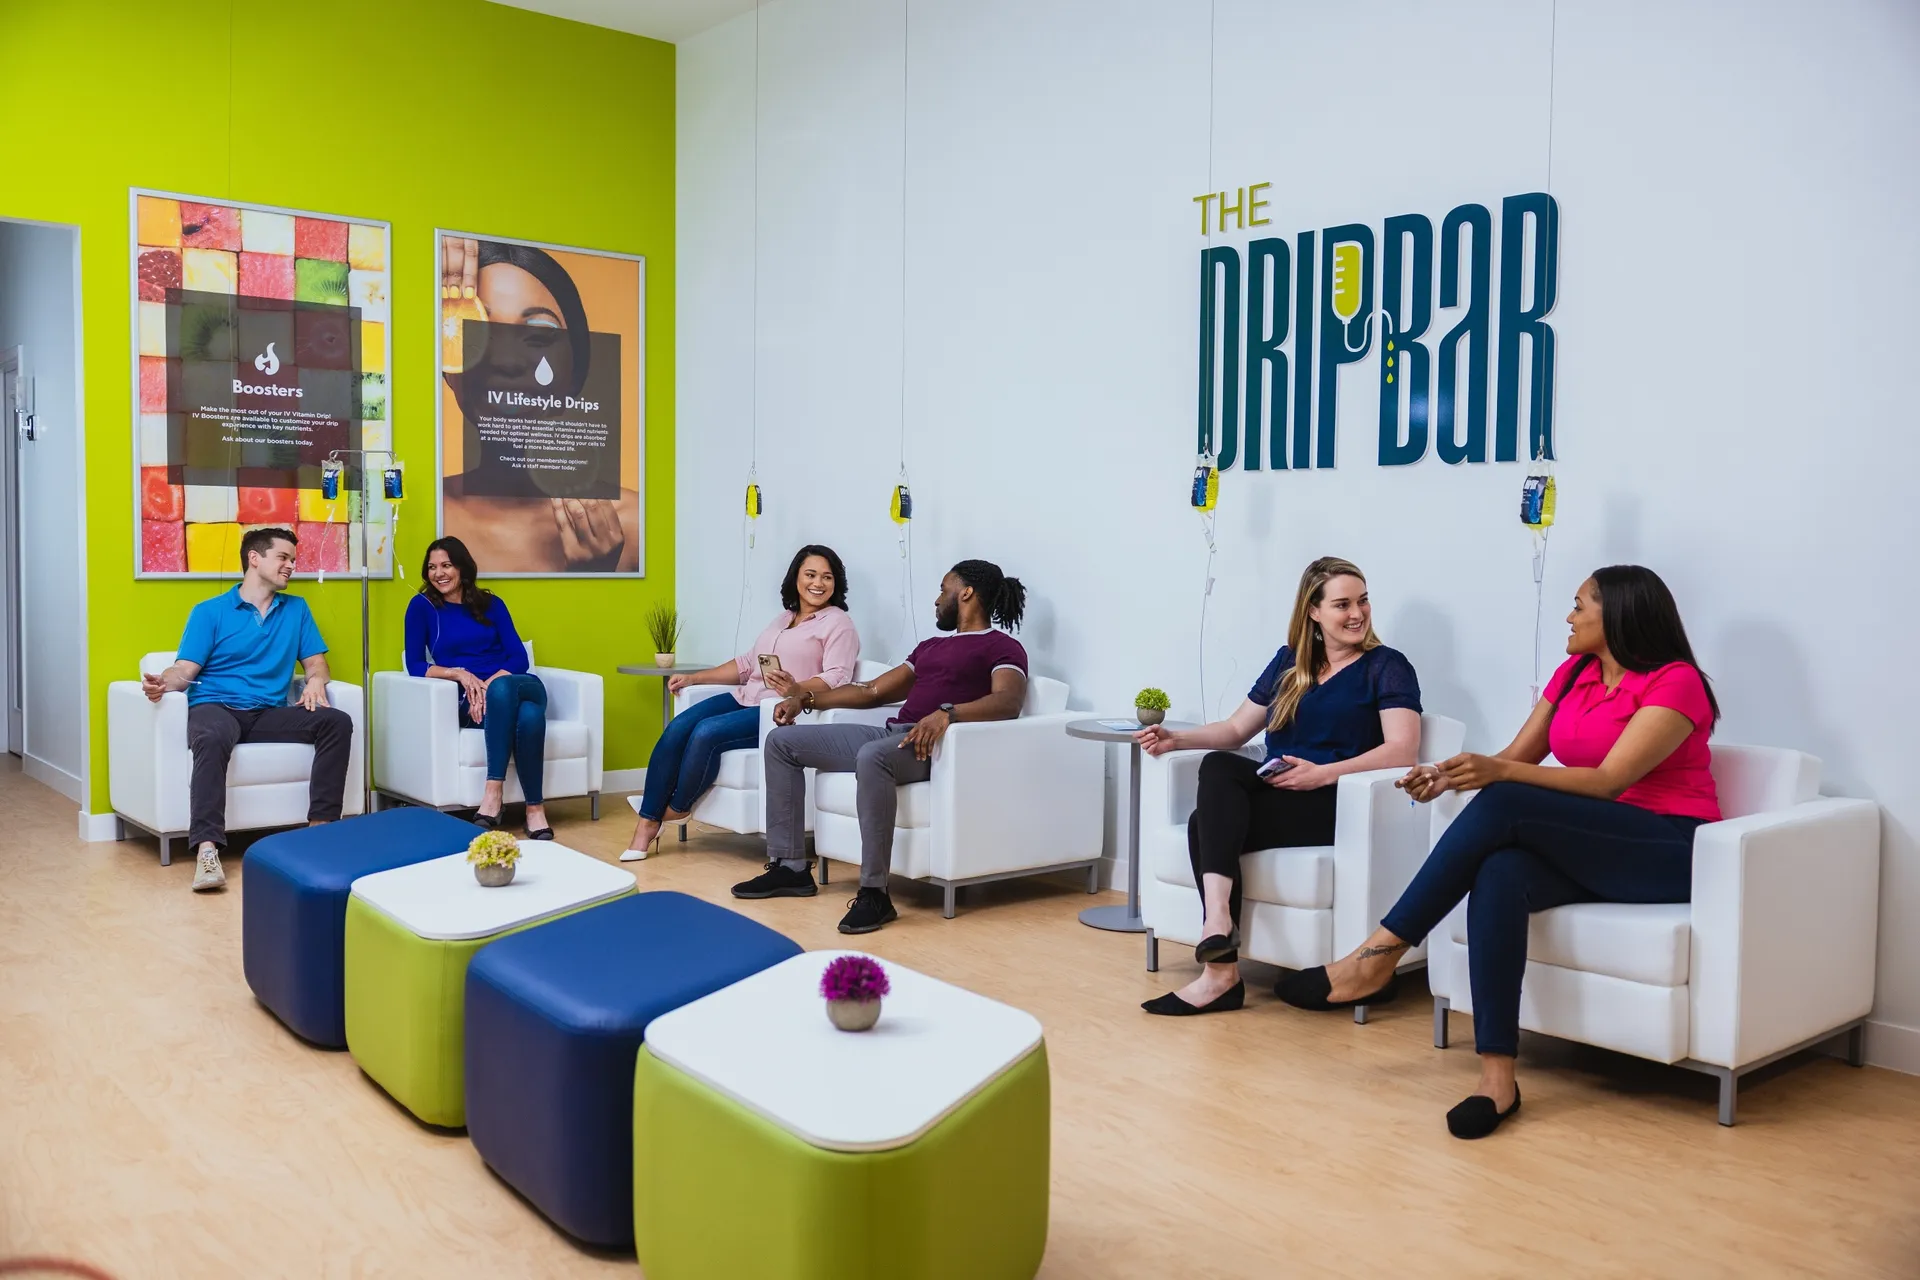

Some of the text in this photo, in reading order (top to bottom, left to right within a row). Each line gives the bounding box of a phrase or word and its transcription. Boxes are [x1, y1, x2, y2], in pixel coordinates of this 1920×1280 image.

[1193, 181, 1273, 236] THE
[233, 379, 303, 398] Boosters
[487, 390, 600, 413] IV Lifestyle Drips
